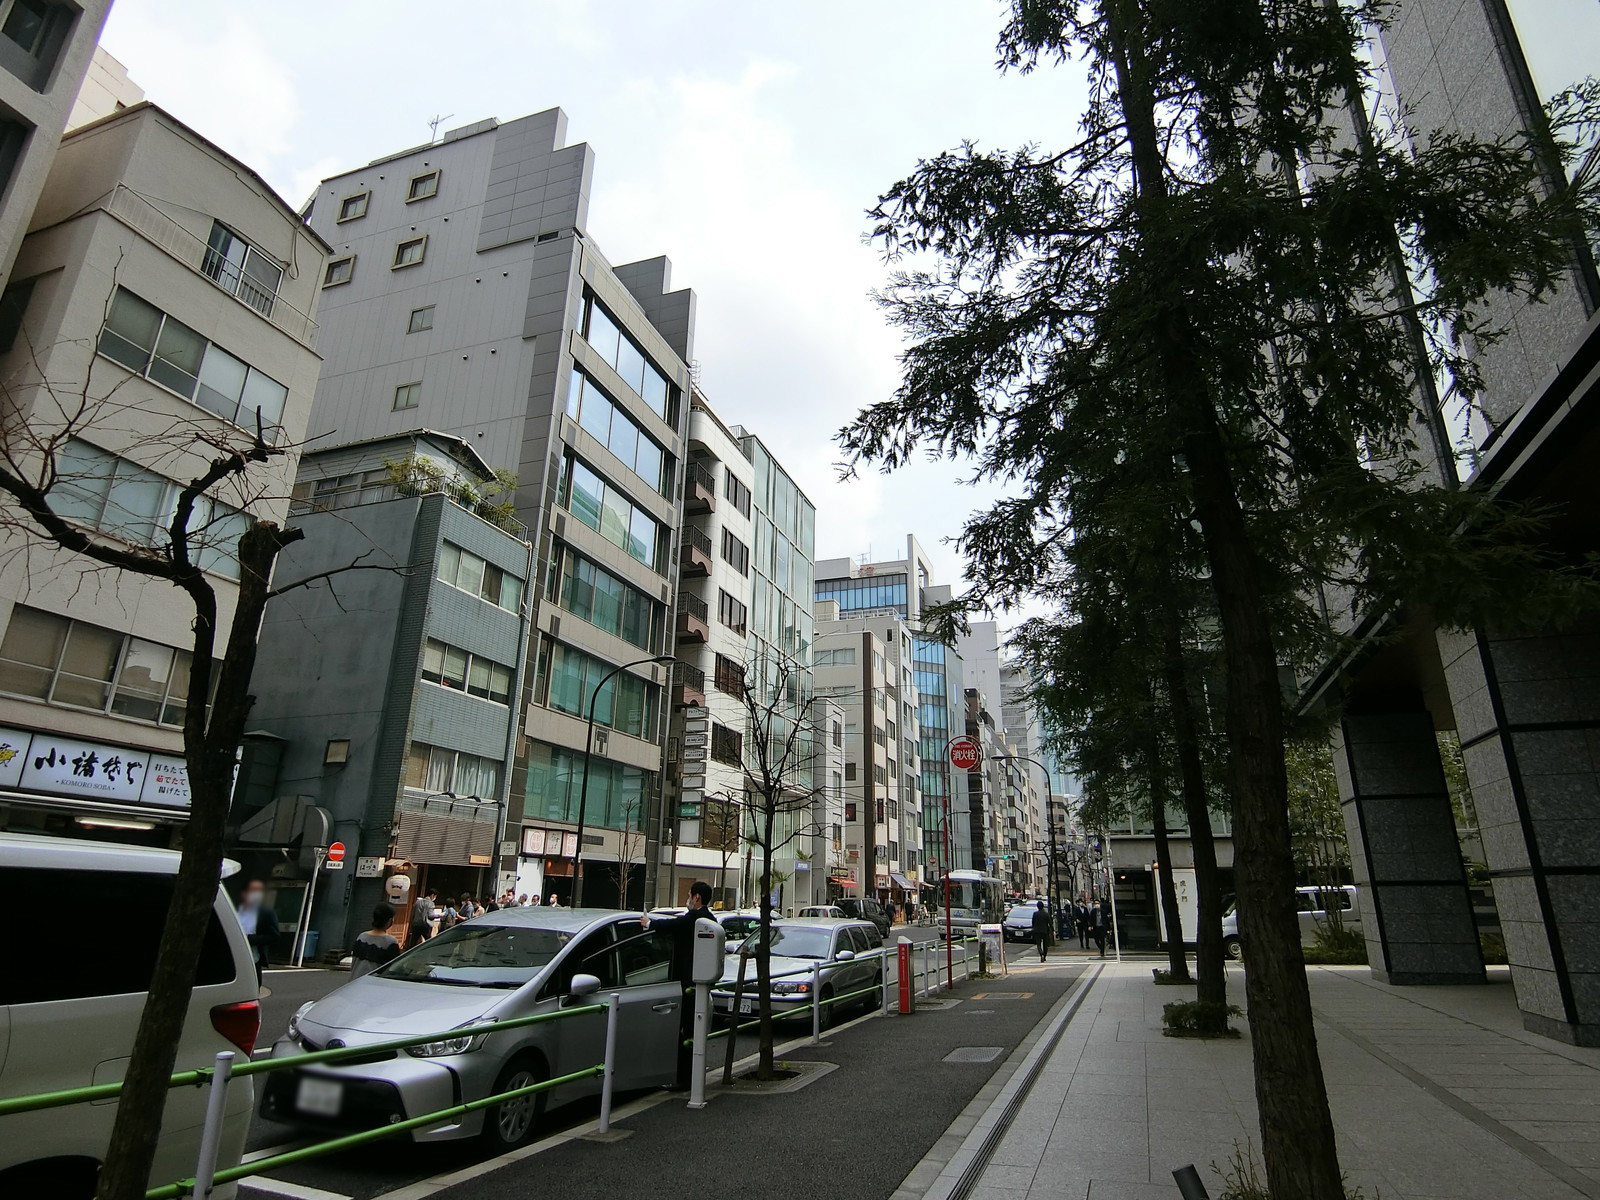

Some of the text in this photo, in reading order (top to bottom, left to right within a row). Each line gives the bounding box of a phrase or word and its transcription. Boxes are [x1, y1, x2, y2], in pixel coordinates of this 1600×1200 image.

[952, 748, 976, 760] 消火栓
[155, 763, 185, 775] 打ちたて
[60, 779, 111, 791] KOMORO SOBA
[156, 774, 187, 786] 茹でたて
[158, 786, 189, 797] 揚げたて
